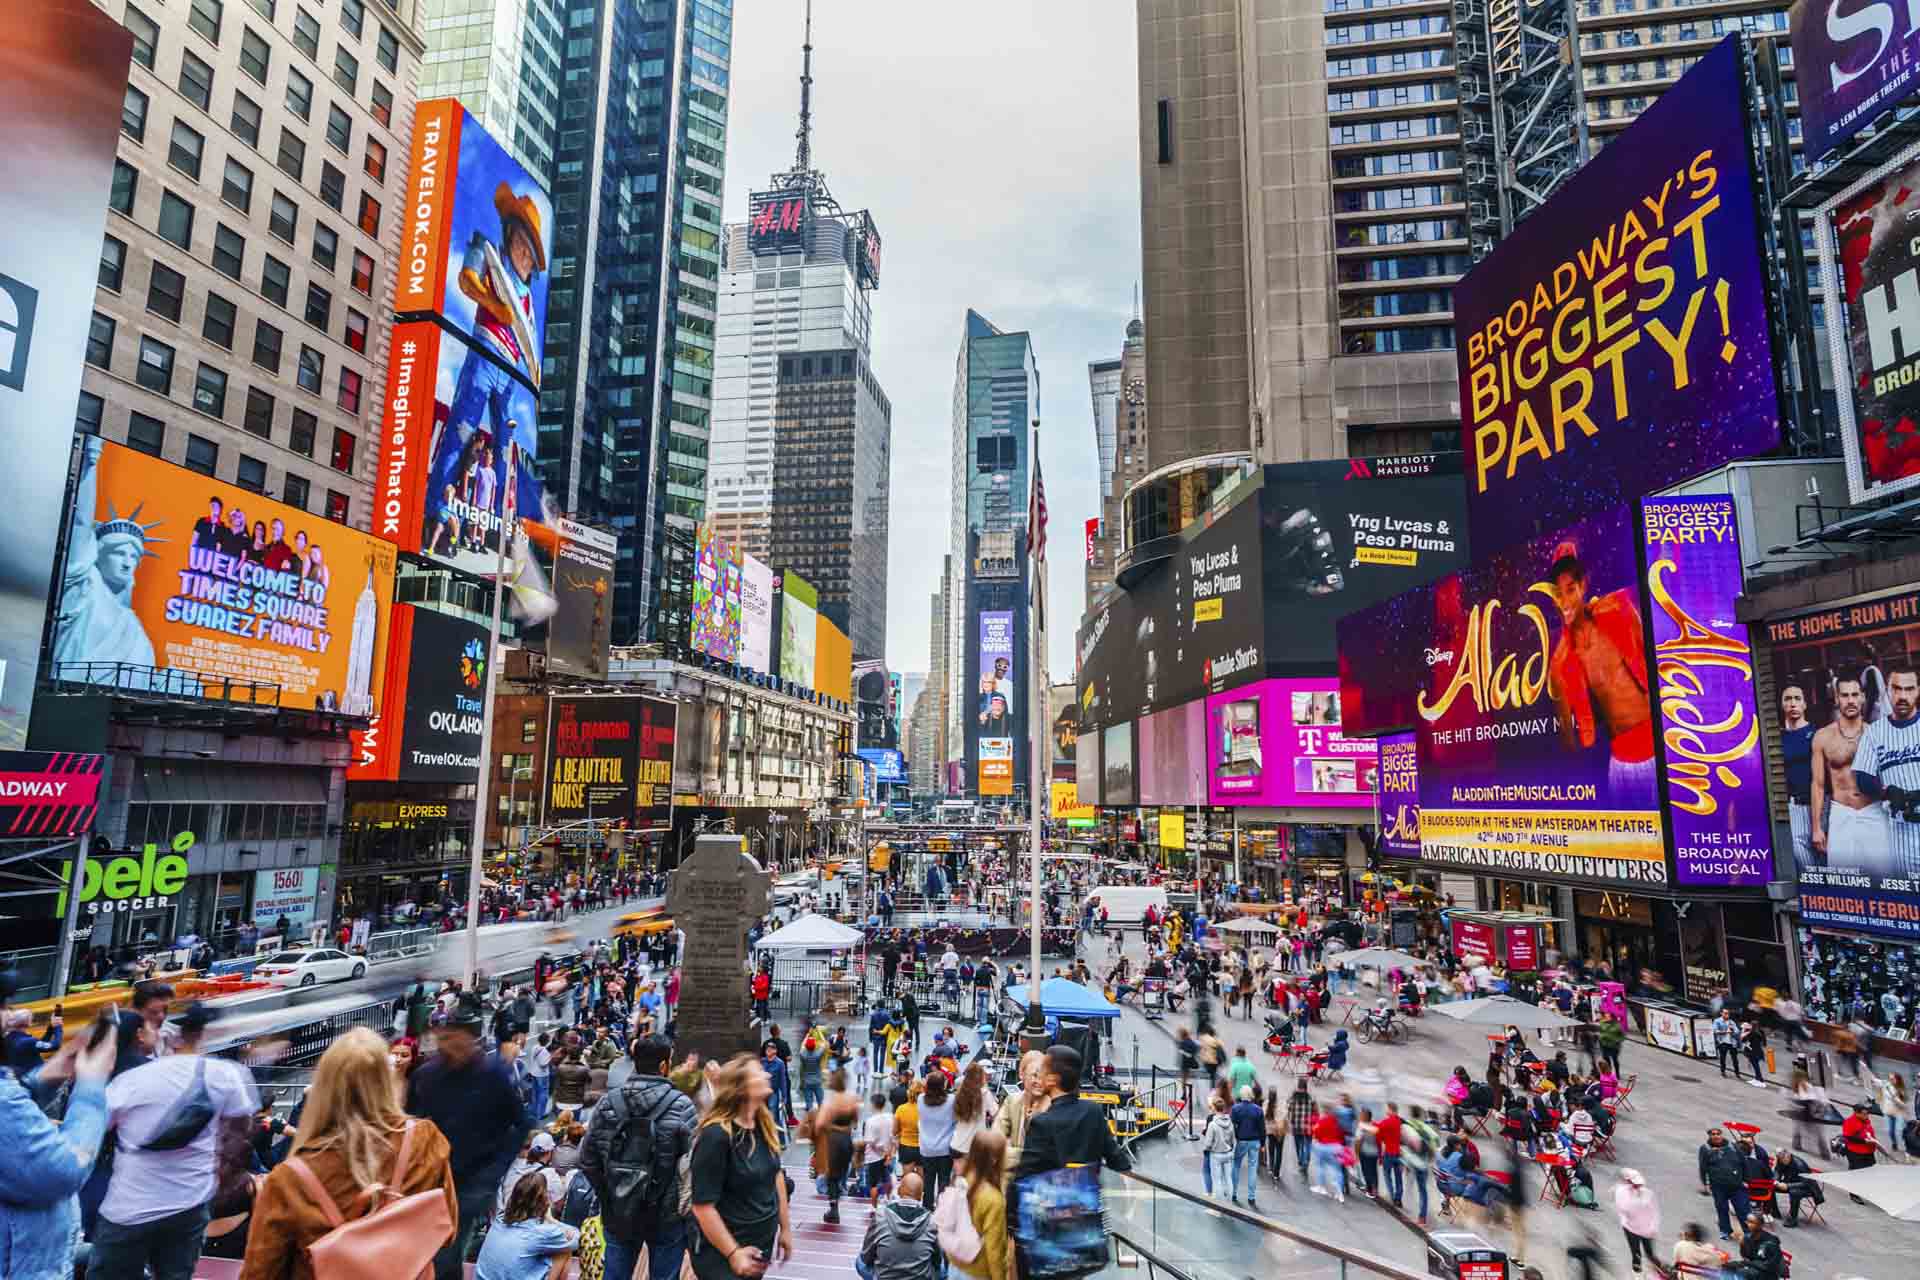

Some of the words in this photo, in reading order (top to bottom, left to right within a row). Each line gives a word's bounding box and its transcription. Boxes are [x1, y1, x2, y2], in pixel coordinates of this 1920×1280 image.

[1880, 47, 1911, 80] THE
[1880, 70, 1911, 101] THEATRE
[408, 116, 441, 294] TRAVELOK.COM
[1468, 149, 1719, 369] BROADWAY'S
[1473, 196, 1721, 423] BIGGEST
[1474, 277, 1737, 493] PARTY!
[1376, 455, 1436, 466] MARRIOTT
[1377, 465, 1430, 475] MARQUIS
[1643, 502, 1731, 514] BROADWAY'S
[562, 521, 584, 536] MoMA
[1348, 513, 1379, 532] Yng
[1384, 516, 1433, 533] Lvcas
[1437, 520, 1449, 535] &
[1645, 511, 1731, 529] BIGGEST
[1354, 531, 1396, 547] Peso
[1400, 534, 1455, 552] Pluma
[1646, 525, 1735, 544] PARTY!
[1190, 556, 1205, 577] Yng
[1206, 551, 1230, 571] Lvcas
[1231, 544, 1239, 564] &
[188, 545, 299, 594] WELCOME
[301, 577, 326, 605] TO
[1193, 579, 1212, 598] Peso
[1214, 572, 1241, 594] Pluma
[178, 570, 250, 610] TIMES
[253, 591, 329, 630] SQUARE
[165, 596, 257, 638] SUAREZ
[257, 617, 331, 654] FAMILY
[1769, 621, 1797, 641] THE
[1800, 604, 1887, 636] HOME-RUN
[1890, 597, 1919, 620] HIT
[1235, 645, 1257, 672] Shorts
[1417, 582, 1562, 721] Alad
[1424, 647, 1454, 666] Disney
[1648, 559, 1760, 816] Aladdin
[456, 694, 482, 713] Trave
[430, 711, 483, 736] OKLAHO
[1432, 731, 1453, 745] THE
[1455, 727, 1472, 743] HIT
[1476, 718, 1548, 741] BROADWAY
[553, 757, 561, 783] A
[564, 757, 624, 783] BEAUTIFUL
[1383, 753, 1417, 772] BIGGE
[1384, 771, 1418, 793] PART
[552, 783, 585, 808] NOISE
[400, 805, 448, 817] EXPRESS
[1384, 804, 1420, 840] Alad
[1427, 816, 1454, 827] BLOCKS
[1455, 816, 1480, 827] SOUTH
[1482, 816, 1492, 828] AT
[1494, 817, 1509, 829] THE
[1512, 817, 1532, 830] NEW
[1536, 818, 1597, 831] AMSTERDAM
[1600, 819, 1657, 837] THEATRE,
[1496, 833, 1514, 844] AND
[1530, 834, 1569, 847] AVENUE
[1690, 832, 1722, 844] THE
[1727, 833, 1752, 845] HIT
[1422, 845, 1488, 866] AMERICAN
[1493, 848, 1541, 872] EAGLE
[1544, 853, 1667, 883] OUTFITTERS
[1678, 847, 1769, 860] BROADWAY
[273, 870, 300, 889] 1560
[1690, 862, 1760, 875] MUSICAL
[1800, 872, 1825, 885] JESSE
[1826, 874, 1871, 888] WILLIAMS
[1880, 878, 1912, 892] JESSE
[87, 896, 170, 915] SOCCER
[1800, 895, 1864, 914] THROUGH
